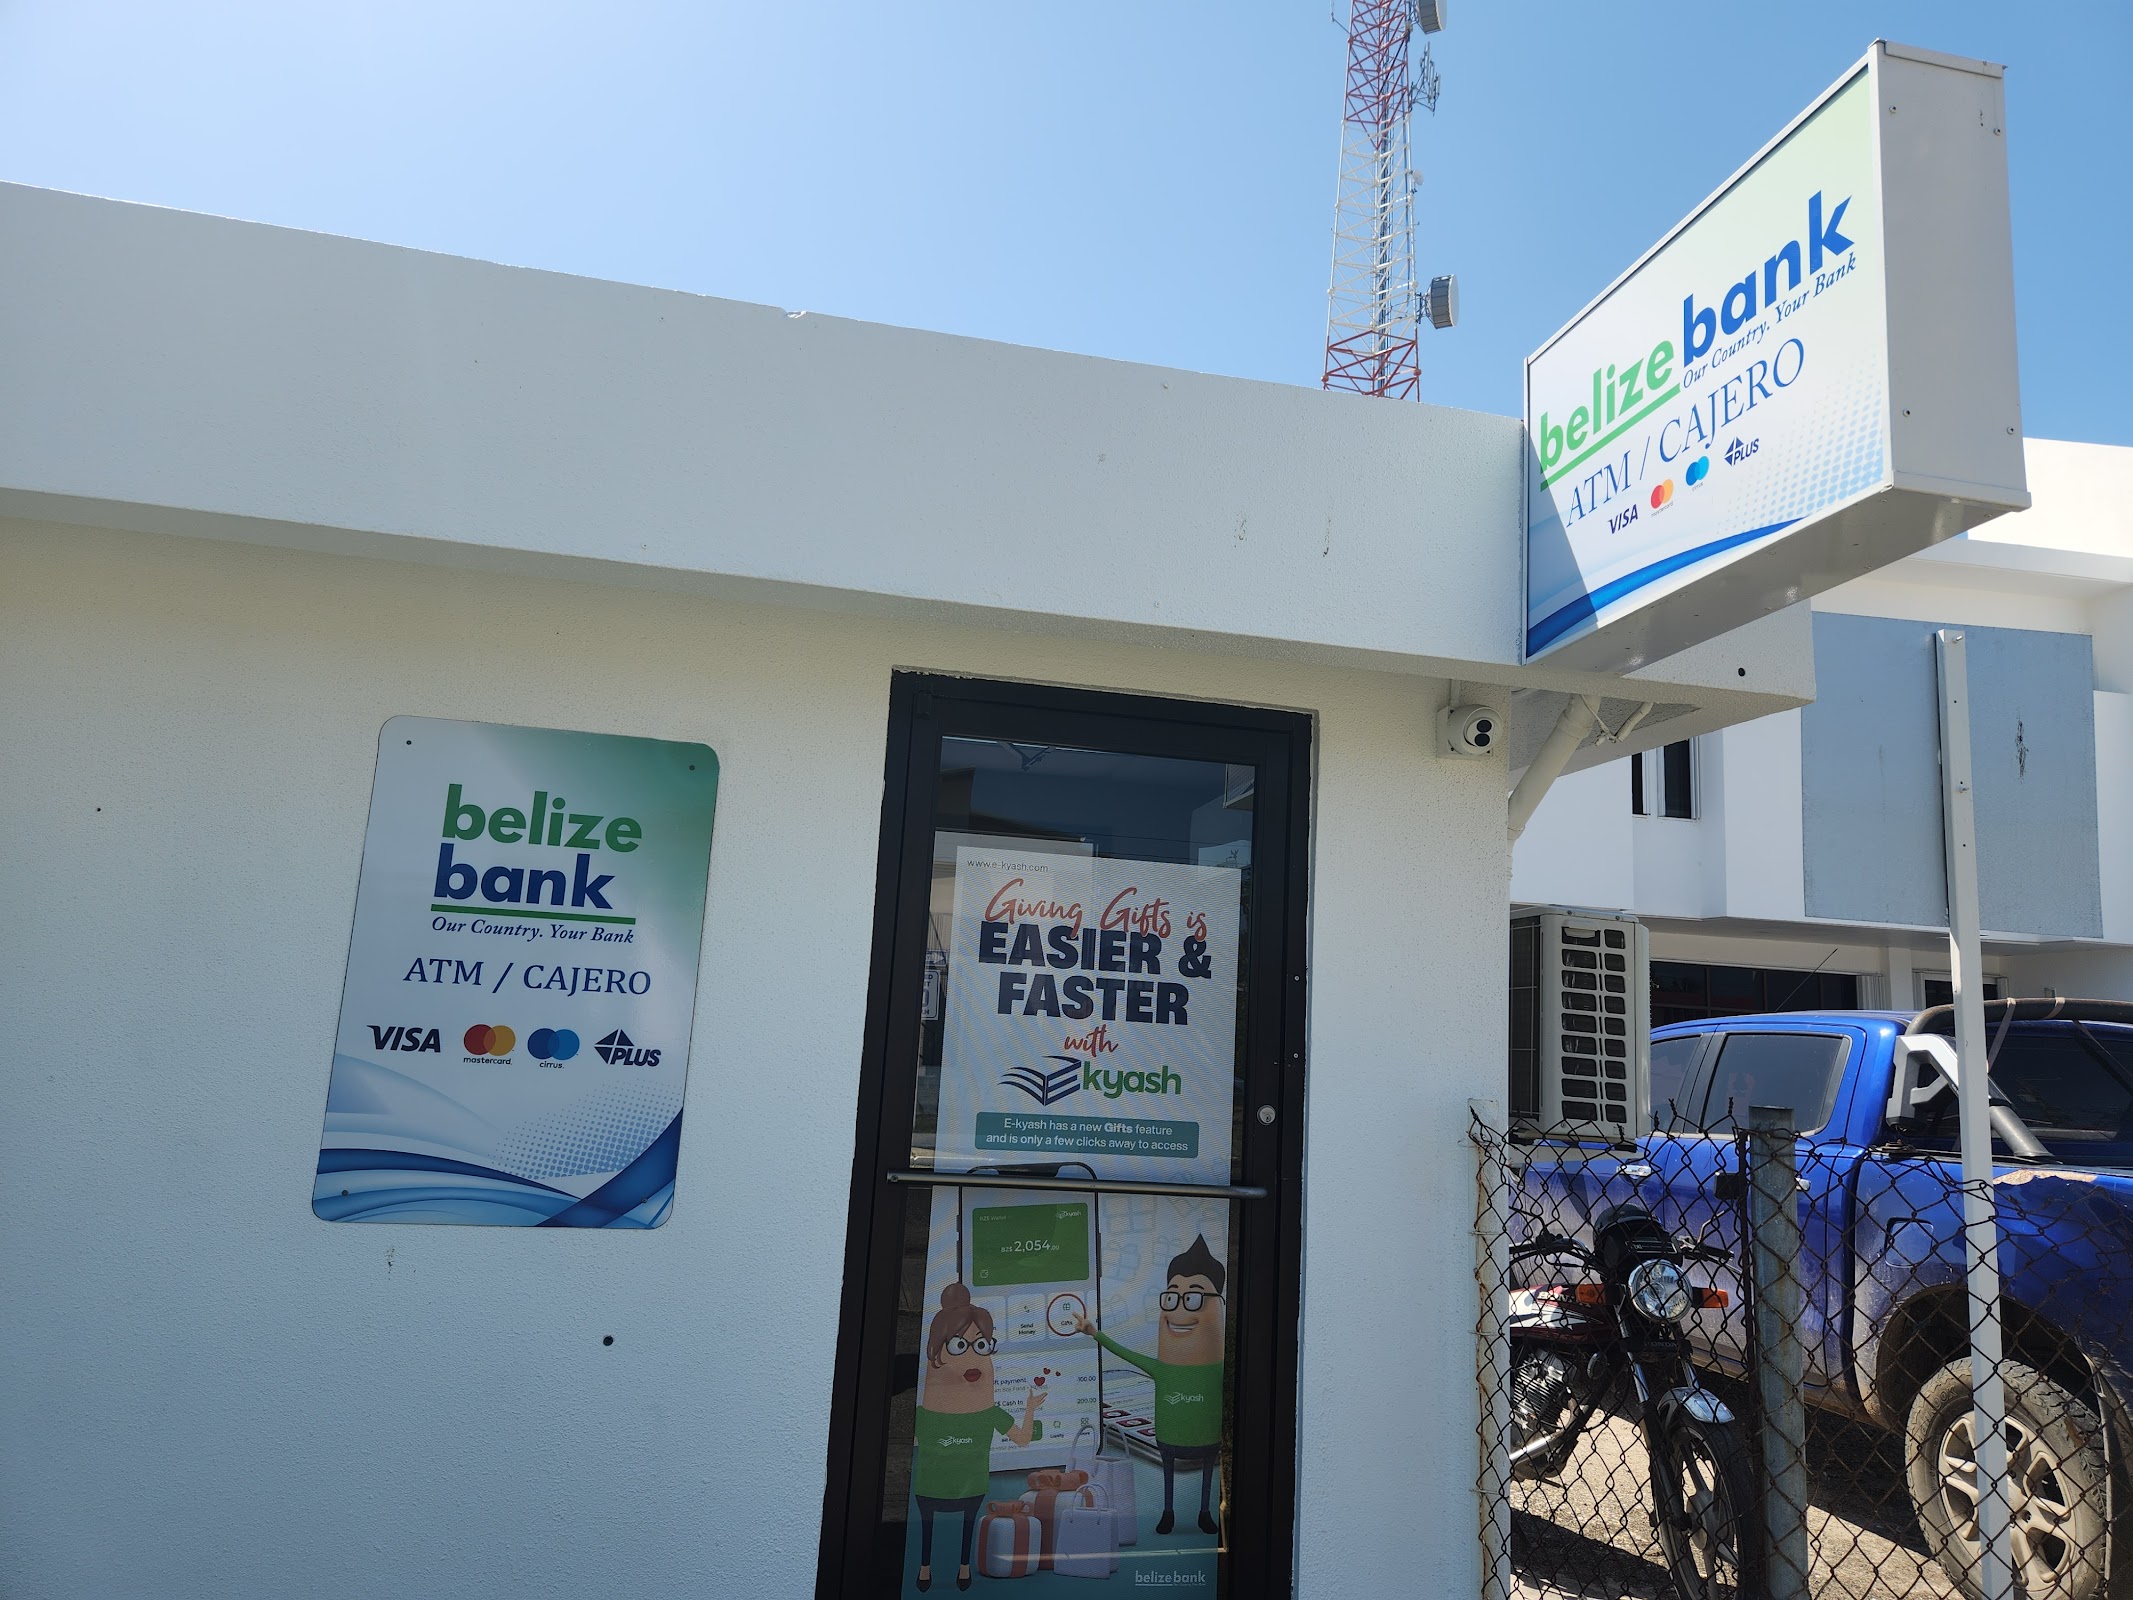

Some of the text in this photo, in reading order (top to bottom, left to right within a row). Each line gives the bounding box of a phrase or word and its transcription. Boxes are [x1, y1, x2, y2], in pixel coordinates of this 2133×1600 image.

[1683, 252, 1857, 389] Our Country. Your Bank
[1566, 337, 1805, 528] ATM / CAJERO
[1733, 438, 1759, 467] PLUS
[1608, 507, 1639, 535] VISA
[441, 783, 643, 853] belize
[433, 842, 616, 910] bank
[967, 859, 1049, 874] www.e-kyash.com
[431, 916, 634, 945] Our Country. Your Bank
[985, 878, 1207, 942] Giving Gifts is
[978, 920, 1212, 979] EASIER &
[403, 956, 652, 998] ATM / CAJERO
[997, 971, 1189, 1026] FASTER
[366, 1024, 662, 1067] VISA PLUS
[1064, 1024, 1118, 1058] with
[986, 1133, 1188, 1152] and is only a few clicks away to access
[1004, 1118, 1173, 1136] E-kyash has a new Gifts feature
